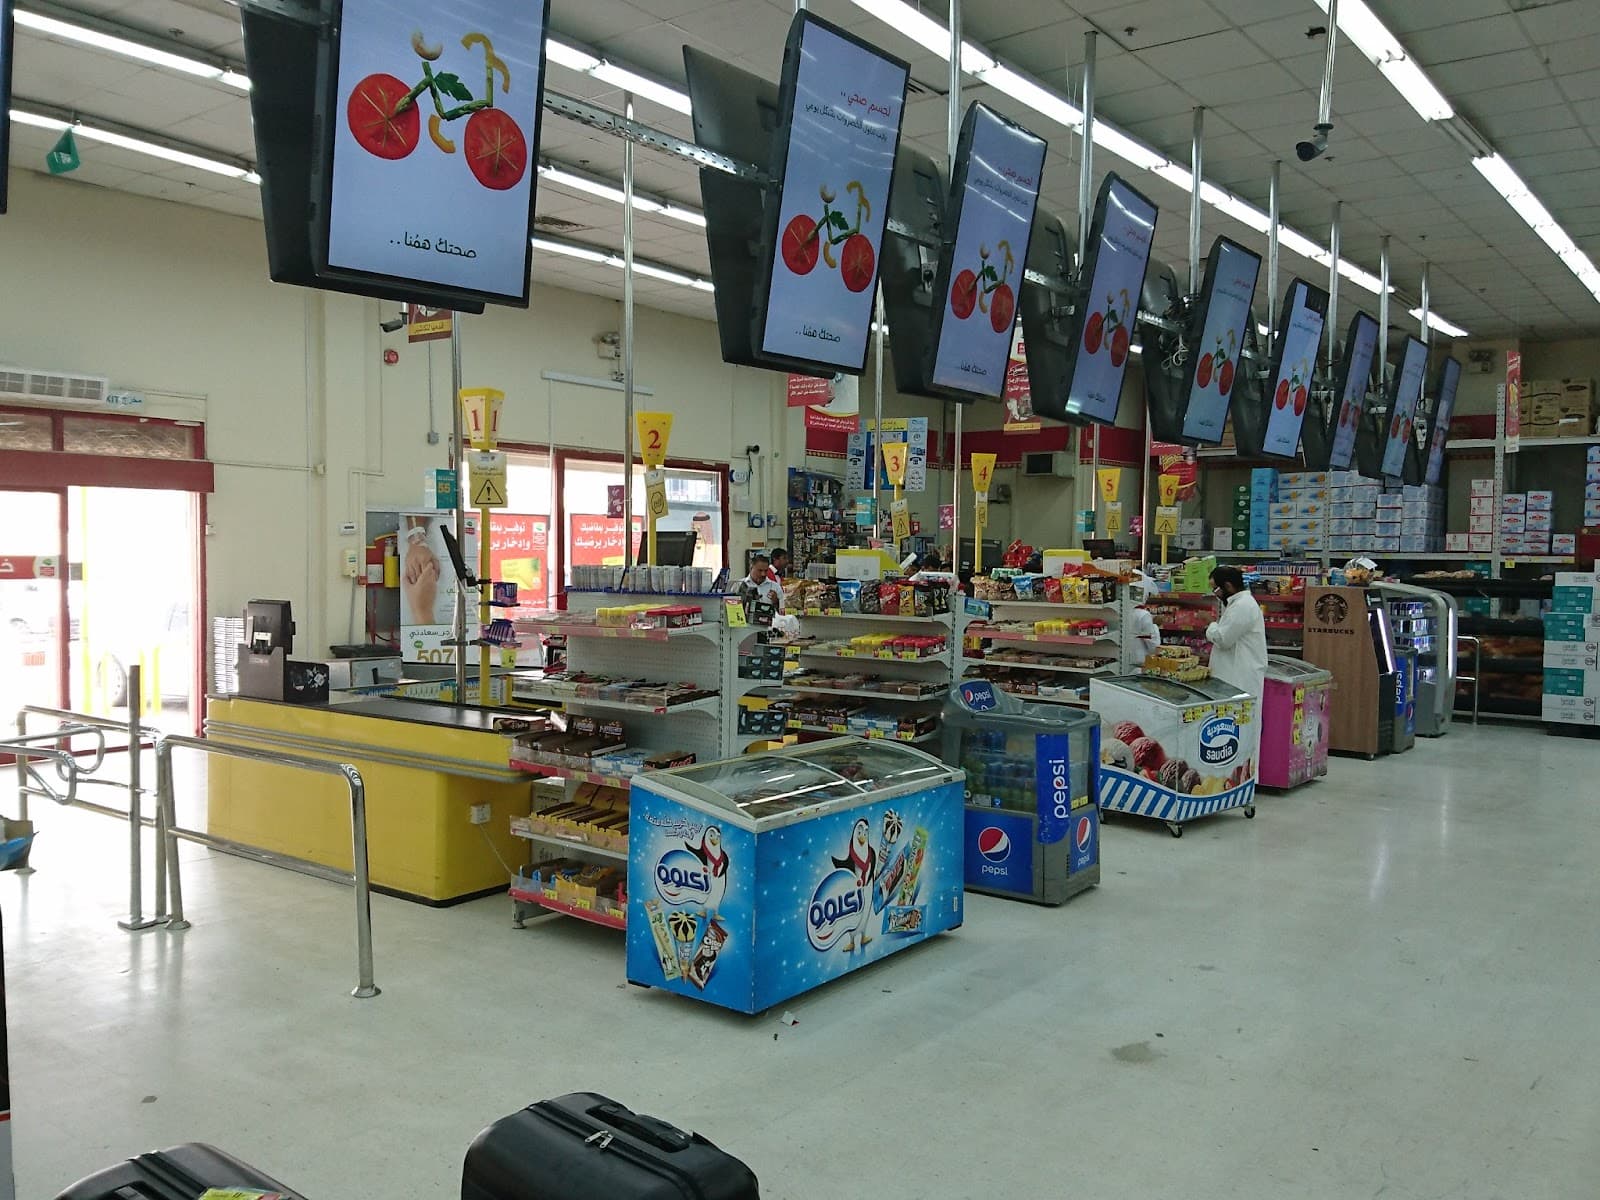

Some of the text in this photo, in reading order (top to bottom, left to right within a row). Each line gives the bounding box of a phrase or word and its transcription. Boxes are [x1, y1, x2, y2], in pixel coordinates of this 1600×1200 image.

[436, 238, 476, 258] صحتك
[470, 410, 481, 431] 1
[491, 410, 498, 432] 1
[648, 430, 662, 449] 2
[890, 456, 900, 472] 3
[978, 466, 988, 480] 4
[1106, 479, 1114, 492] 5
[1166, 484, 1173, 496] 6
[974, 689, 992, 702] pepsi
[1206, 745, 1233, 760] saudia
[1049, 759, 1069, 819] pepsi
[1078, 854, 1090, 866] pepsi
[982, 864, 1008, 876] pepsi
